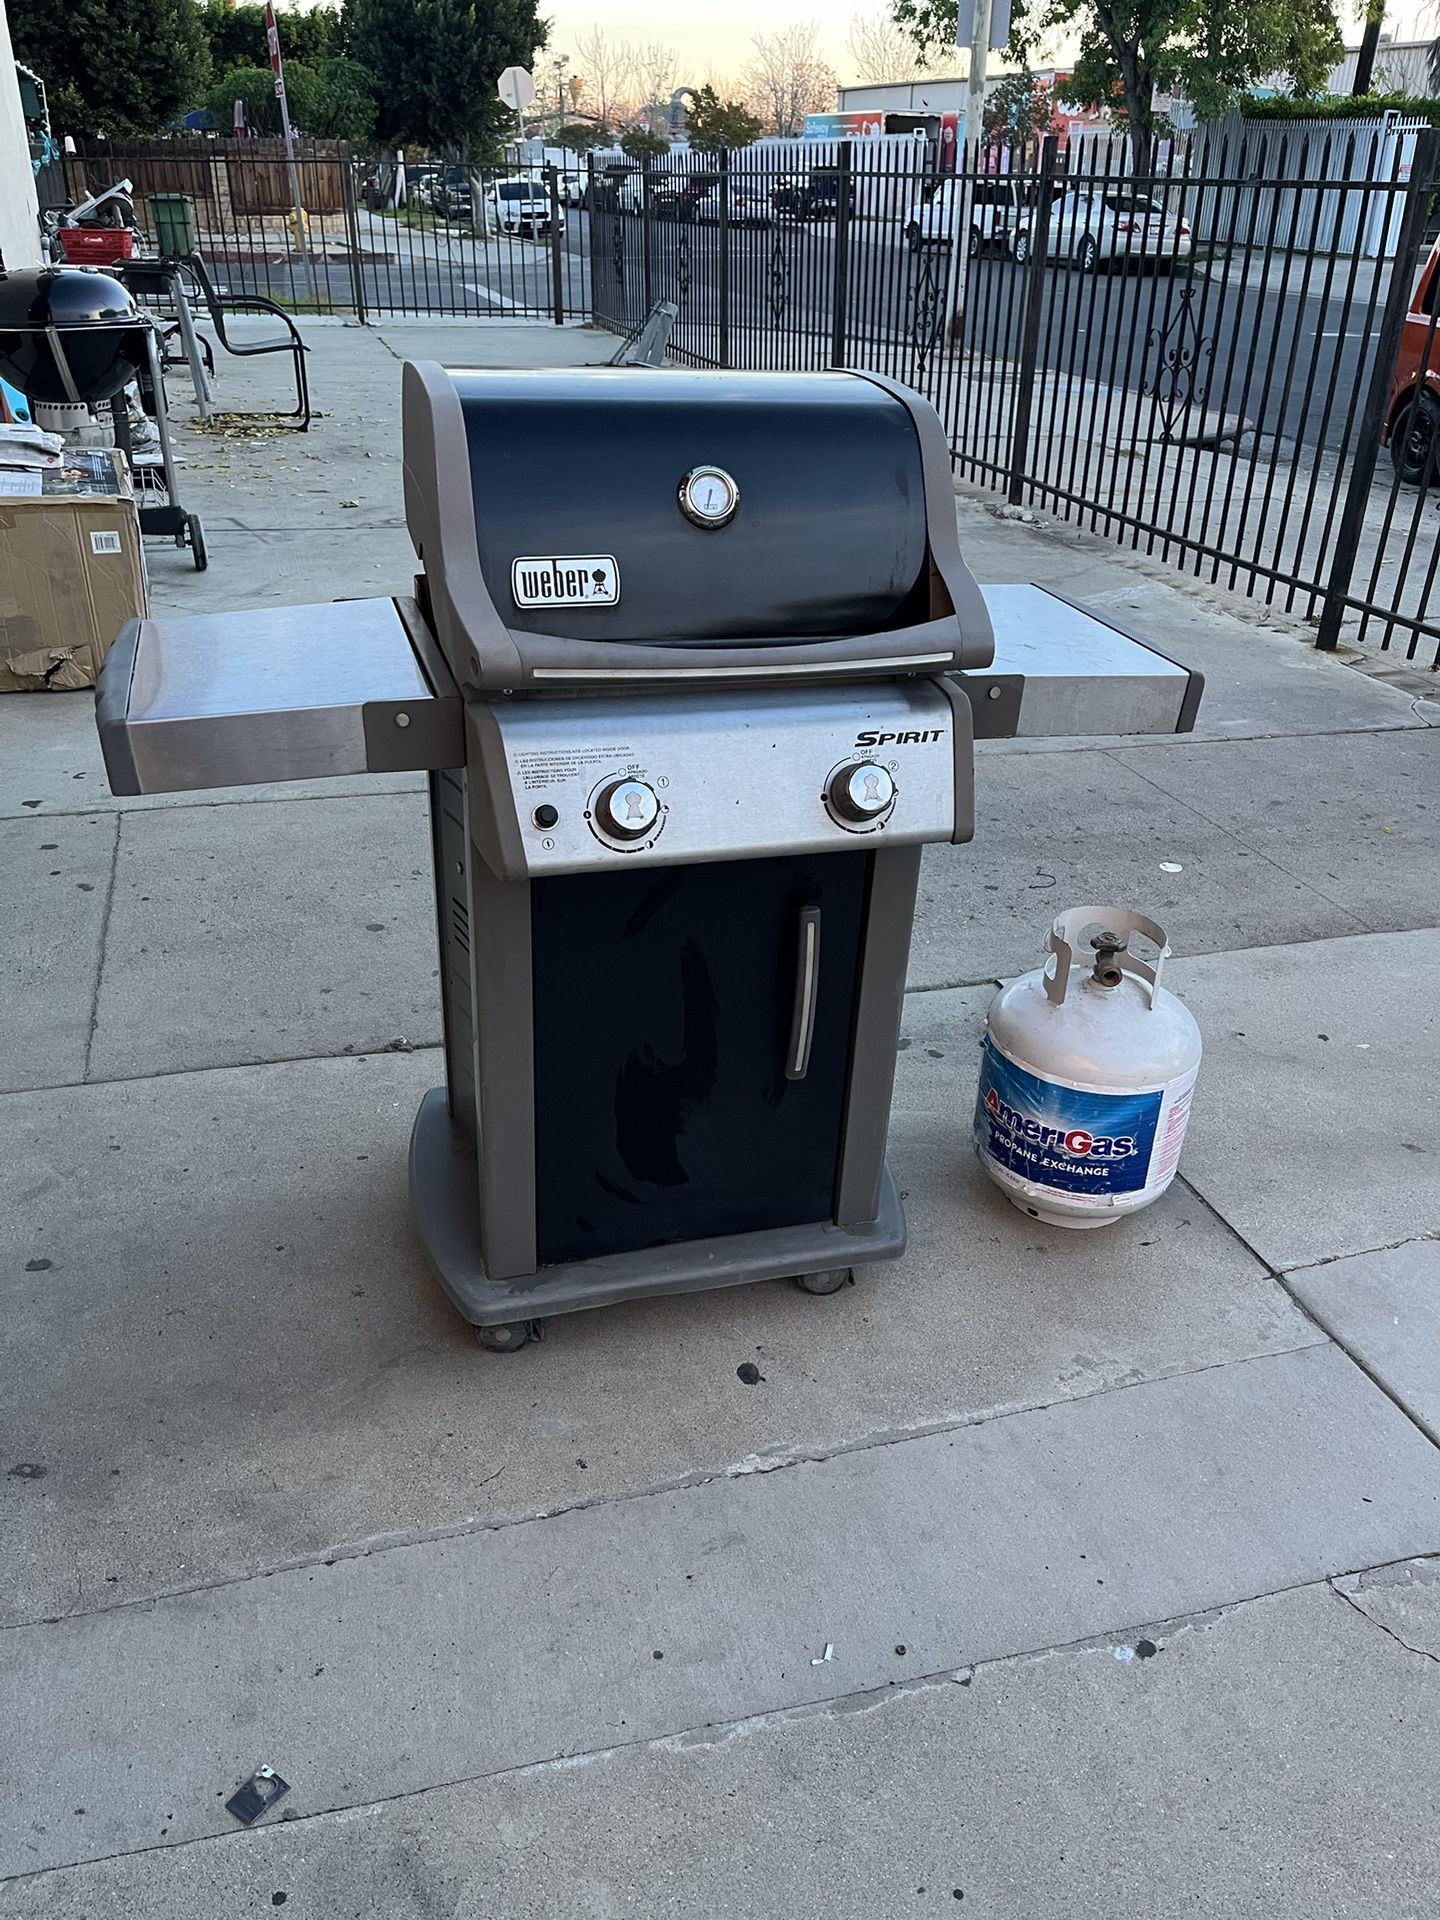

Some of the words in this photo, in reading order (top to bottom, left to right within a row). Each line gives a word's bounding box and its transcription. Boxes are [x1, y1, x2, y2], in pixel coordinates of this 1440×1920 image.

[521, 559, 589, 598] weber
[854, 730, 945, 748] SPIRIT
[994, 1130, 1038, 1163] PROPANE
[1042, 1157, 1110, 1177] EXCHANGE
